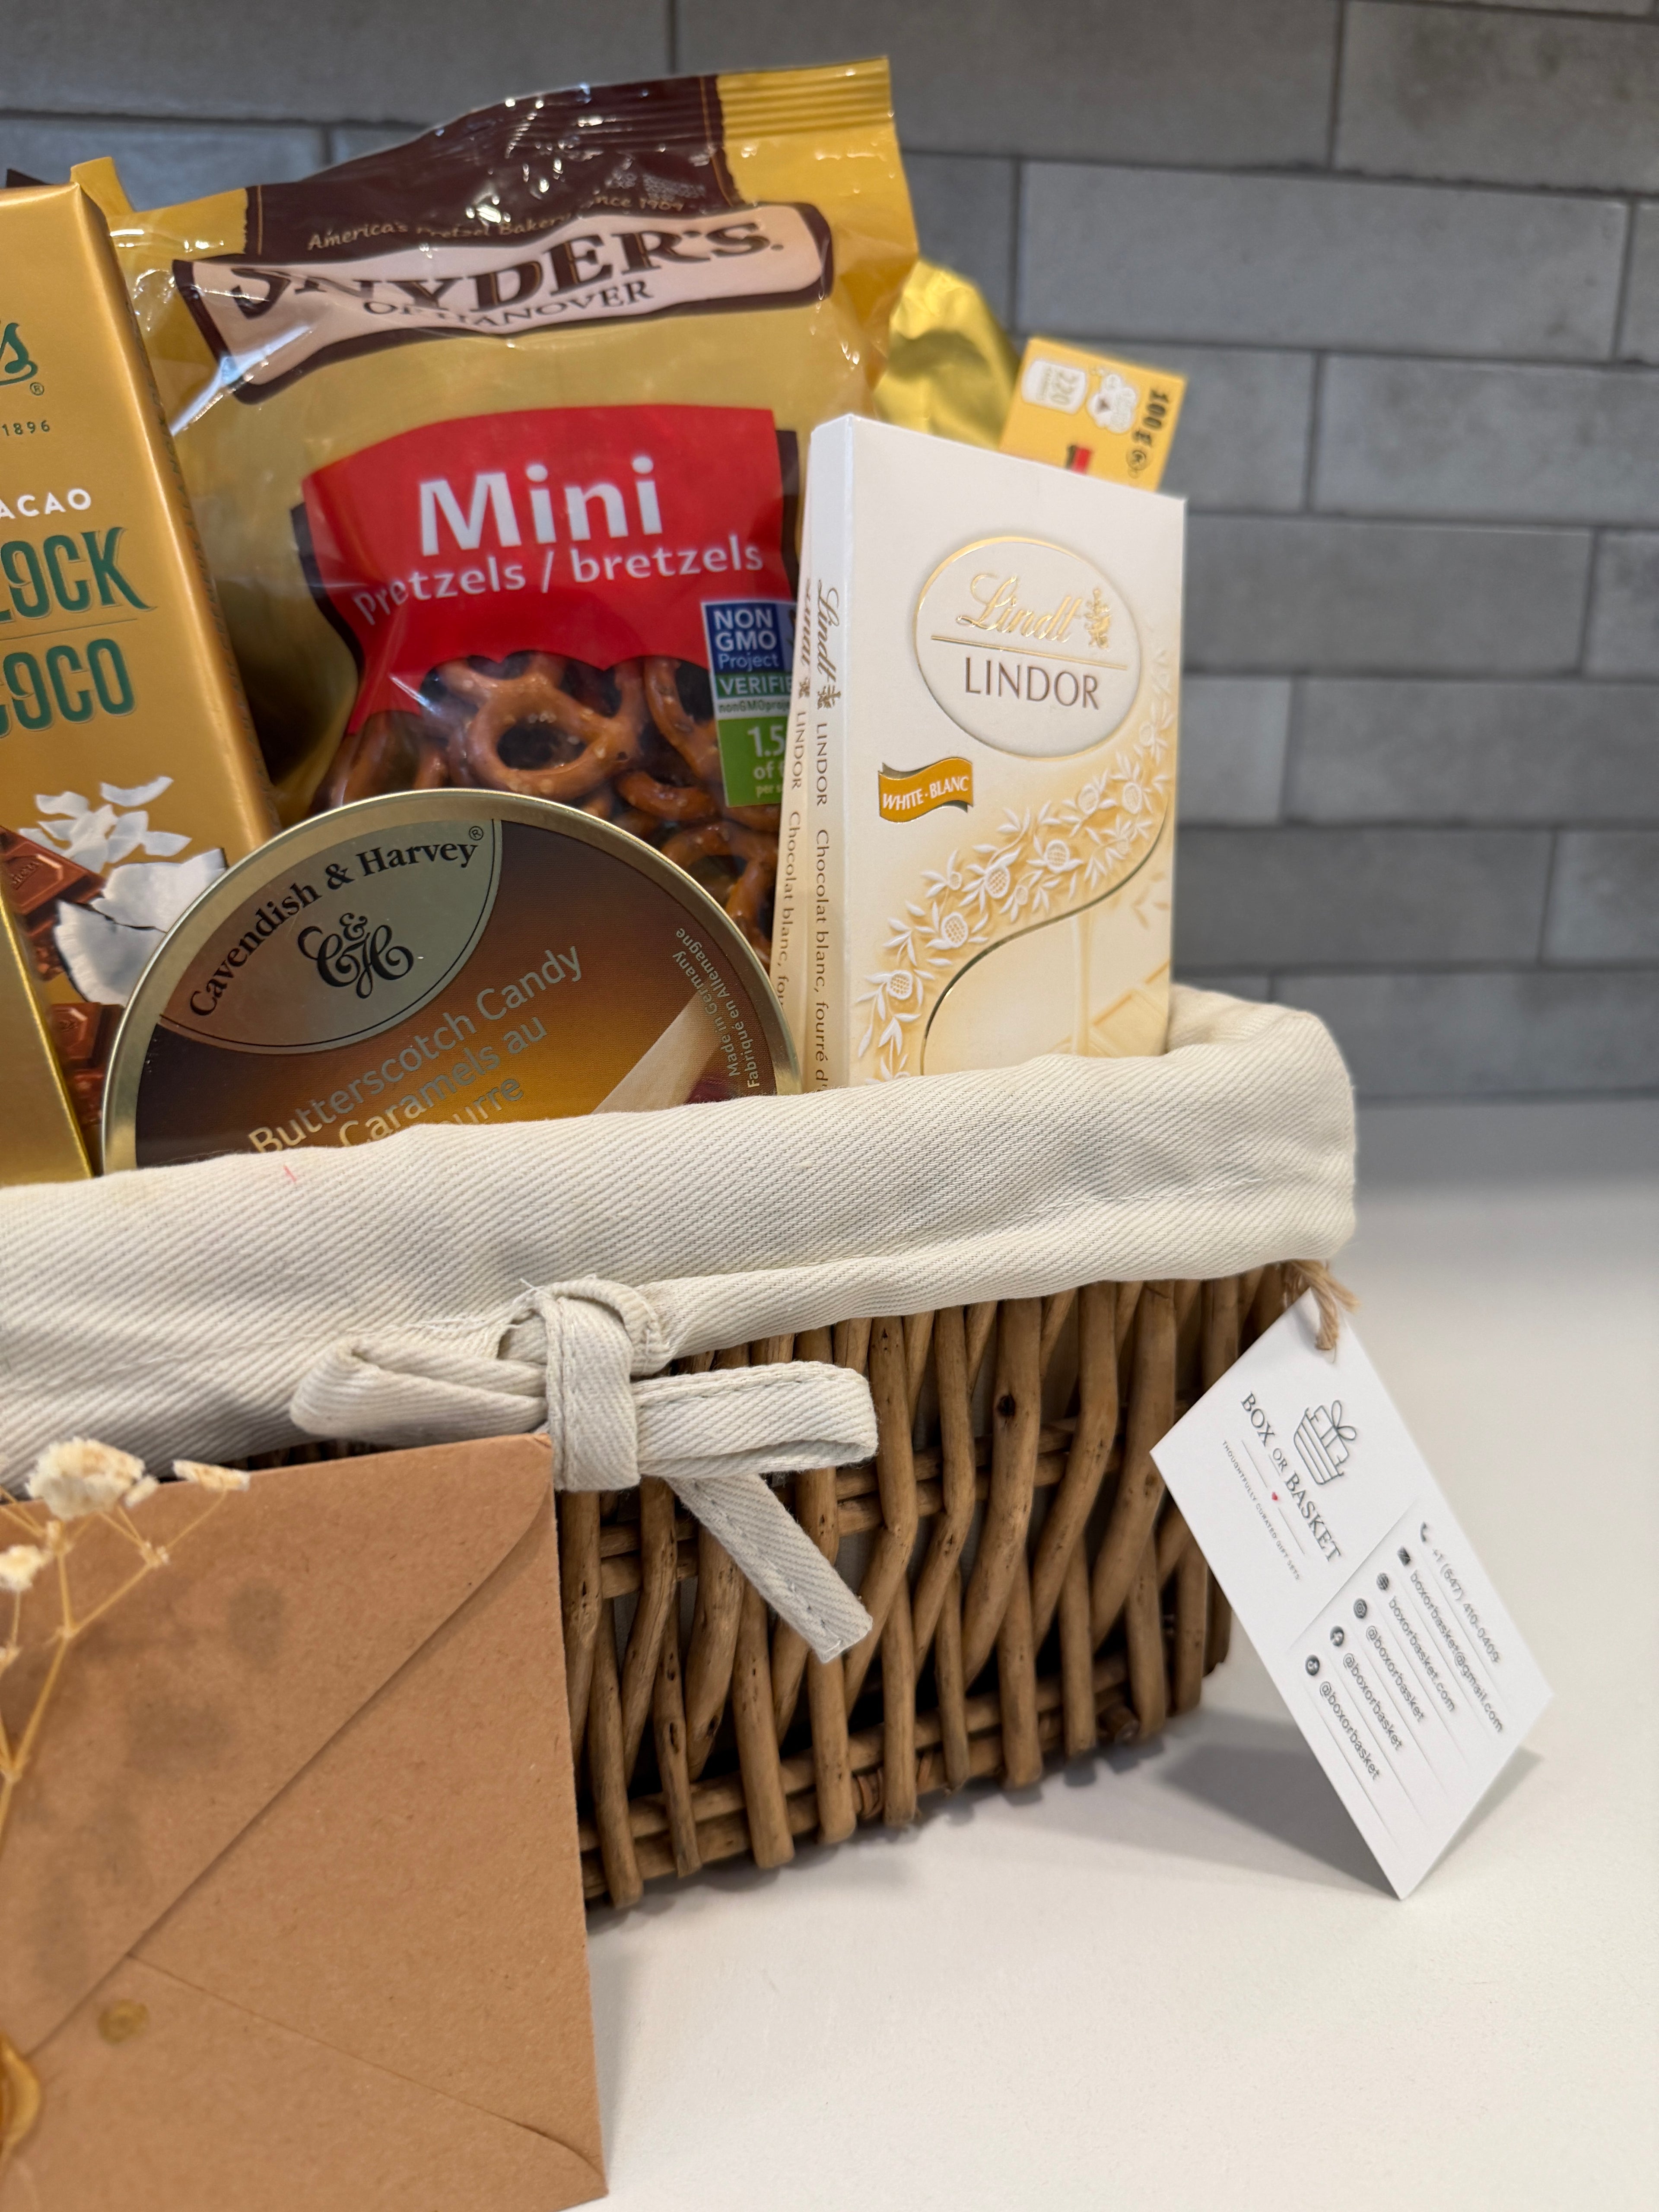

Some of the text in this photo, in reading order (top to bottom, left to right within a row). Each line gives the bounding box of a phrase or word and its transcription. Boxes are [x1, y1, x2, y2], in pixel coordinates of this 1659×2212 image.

[2, 420, 51, 436] 1896
[419, 456, 662, 556] Mini
[571, 534, 763, 583] bretzels
[714, 609, 773, 630] NON
[715, 631, 777, 652] GMO
[817, 580, 839, 682] Lindt
[957, 572, 1084, 643] Lindt
[0, 639, 134, 736] OCO
[718, 652, 779, 672] Project
[965, 657, 1100, 710] LINDOR
[753, 761, 774, 779] of
[792, 712, 806, 789] LINDOR
[817, 723, 828, 807] LINDOR
[784, 812, 800, 899] Chocolat
[816, 830, 830, 923] Chocolat
[191, 883, 321, 1016] Cavendish
[325, 863, 355, 890] &
[778, 908, 795, 966] blanc,
[814, 931, 829, 992] blanc,
[248, 946, 582, 1153] Butterscotch Candy
[672, 952, 741, 1077] Made in Germany
[674, 928, 760, 1088] Fabriqué en Allemagne
[816, 1001, 829, 1062] fourré
[339, 1017, 547, 1147] Caramels au
[1222, 1440, 1258, 1501] THOUGHTFULLY
[1241, 1392, 1342, 1562] BOX OR BASKET
[1366, 1625, 1425, 1723] @boxorbasket
[1389, 1596, 1456, 1713] boxorbasket.com
[1411, 1570, 1504, 1733] boxorbasket@gmail.com
[1319, 1681, 1381, 1780] @boxorbasket
[1343, 1653, 1403, 1751] @boxorbasket
